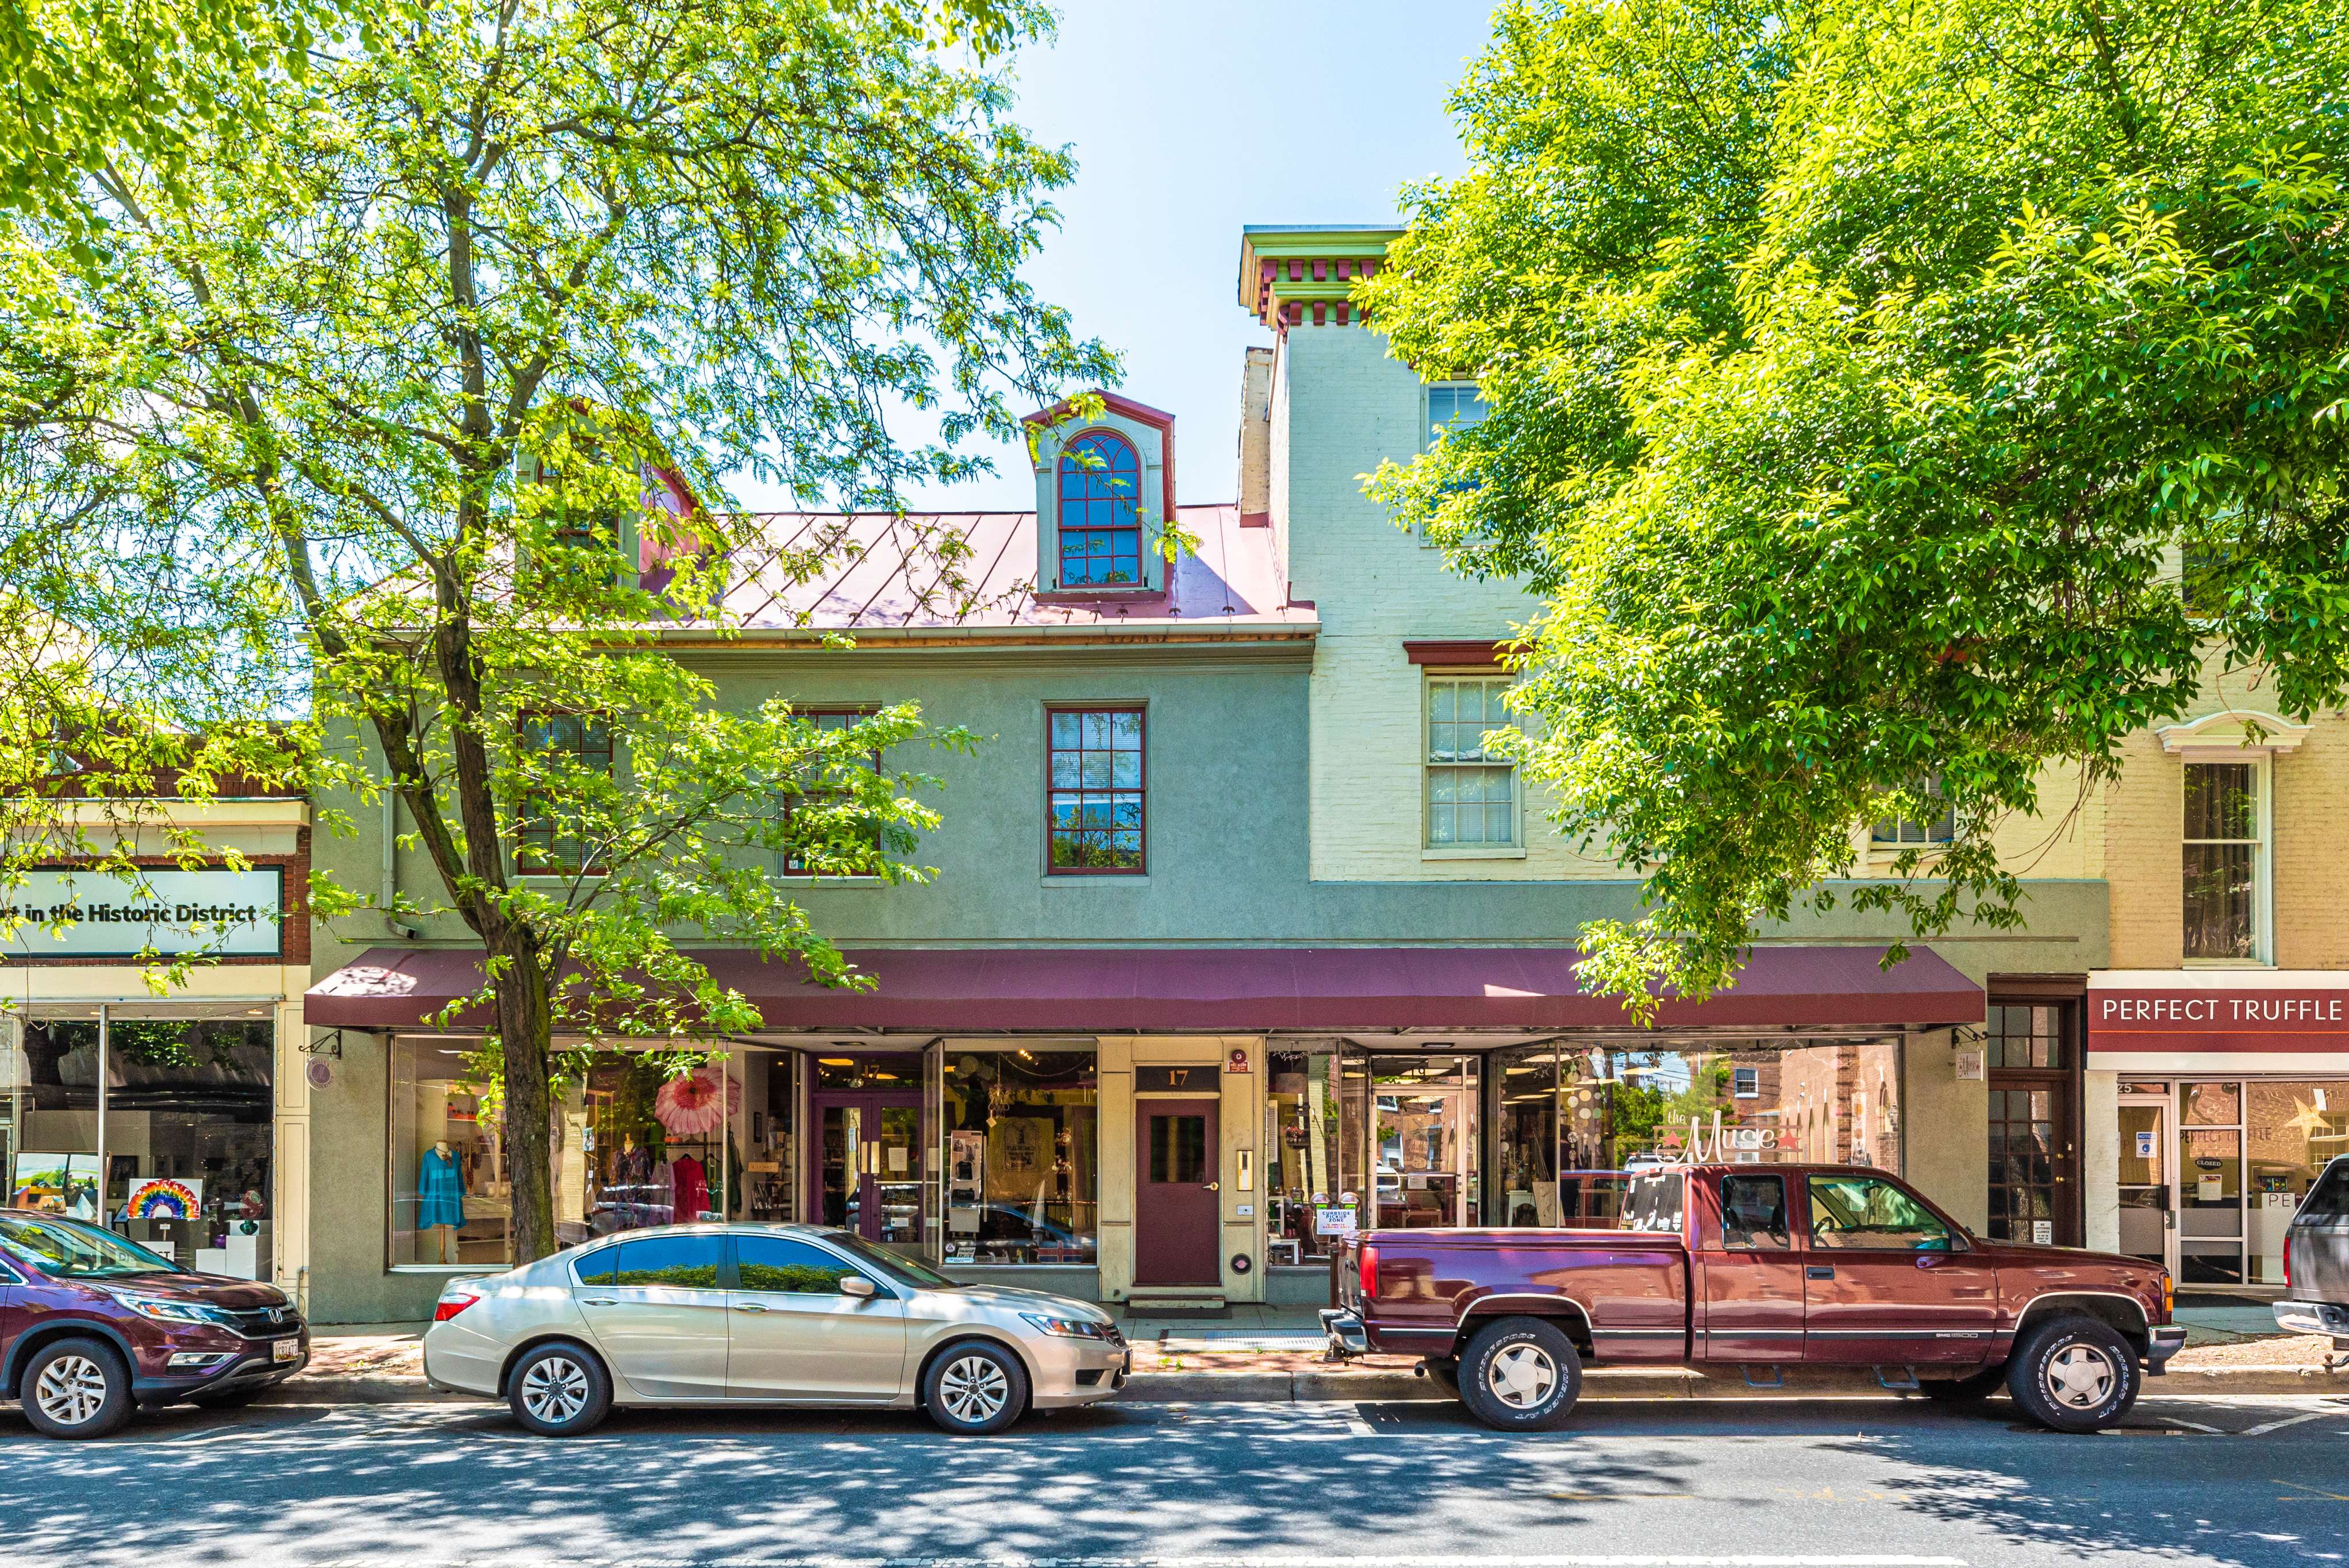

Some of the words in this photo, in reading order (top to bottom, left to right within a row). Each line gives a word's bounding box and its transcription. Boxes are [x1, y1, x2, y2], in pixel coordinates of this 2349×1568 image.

[25, 904, 45, 922] in
[49, 904, 84, 922] the
[88, 904, 171, 923] Historic
[176, 903, 256, 922] District
[2103, 1000, 2219, 1020] PERFECT
[2229, 1000, 2342, 1020] TRUFFLE
[864, 1064, 880, 1079] 17
[1168, 1070, 1189, 1086] 17
[1668, 1109, 1687, 1125] the
[1656, 1109, 1775, 1164] Muse
[1479, 1333, 1536, 1392] BRIDGESTONE
[2038, 1335, 2073, 1410] BRIDGESTONE
